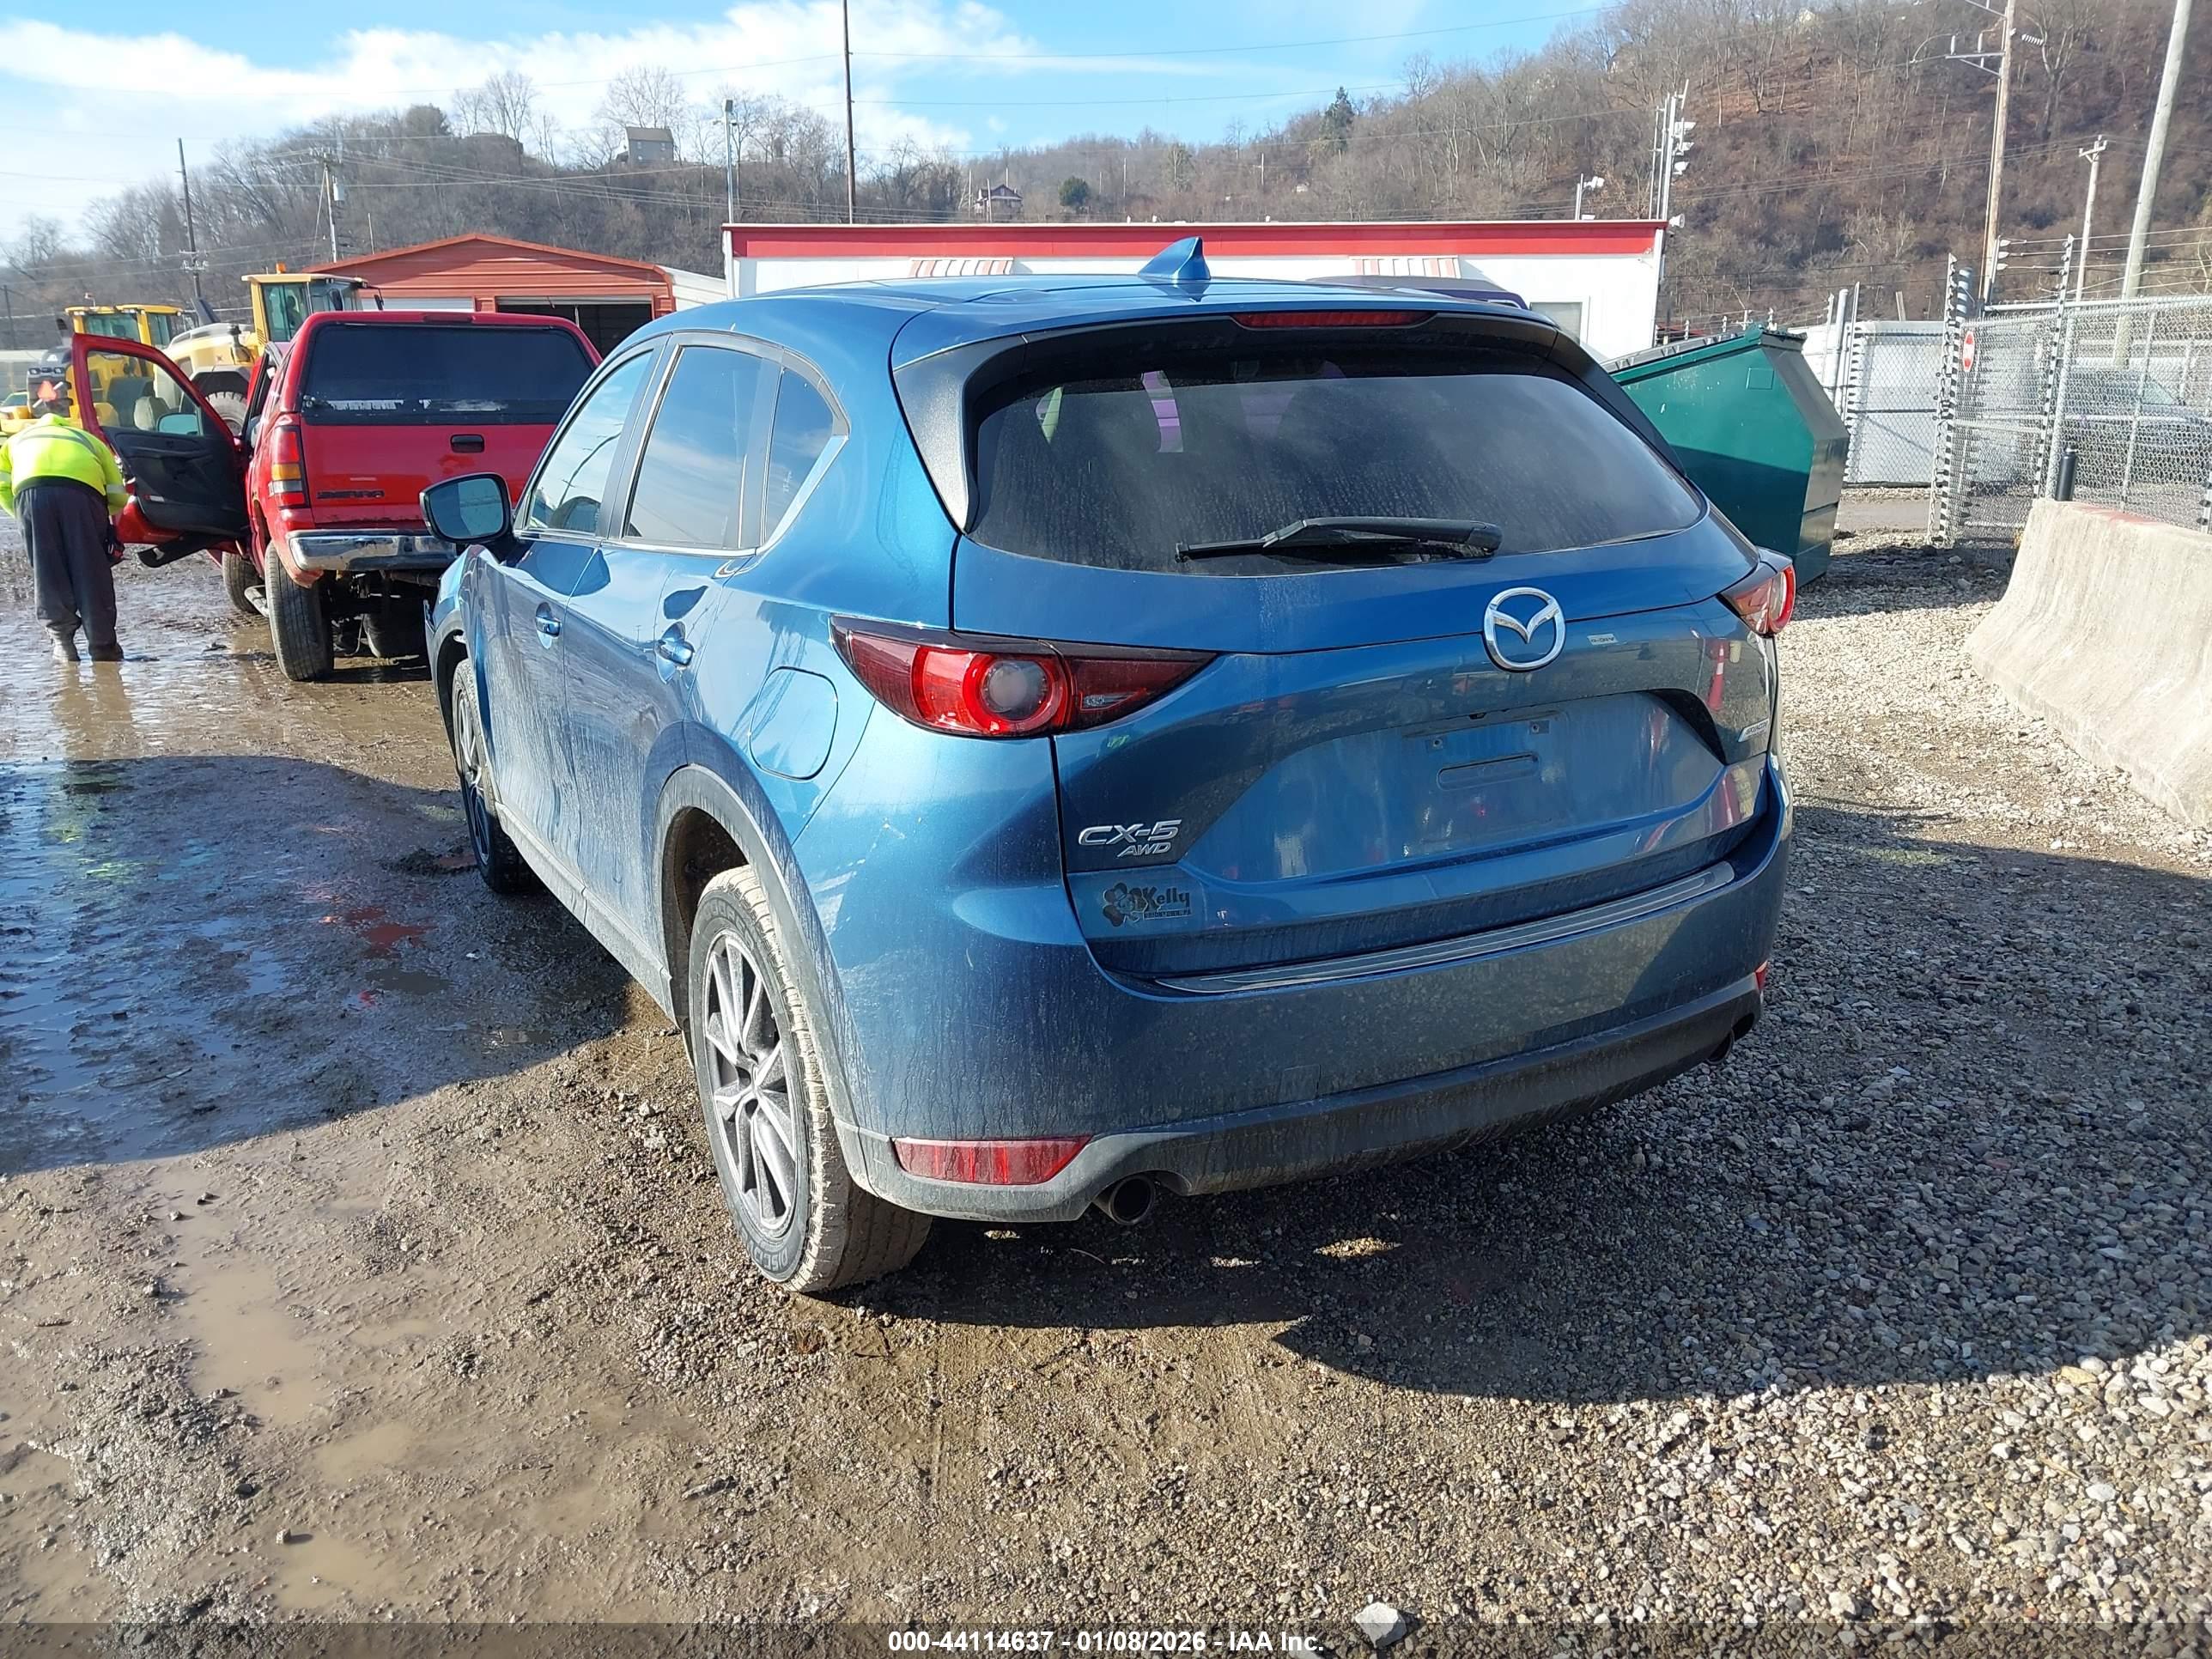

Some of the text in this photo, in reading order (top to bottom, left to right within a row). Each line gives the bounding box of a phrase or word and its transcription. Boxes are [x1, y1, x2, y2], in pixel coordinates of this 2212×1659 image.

[1079, 819, 1182, 846] CX-5
[1117, 842, 1171, 858] AWD
[1142, 886, 1191, 911] Kelly
